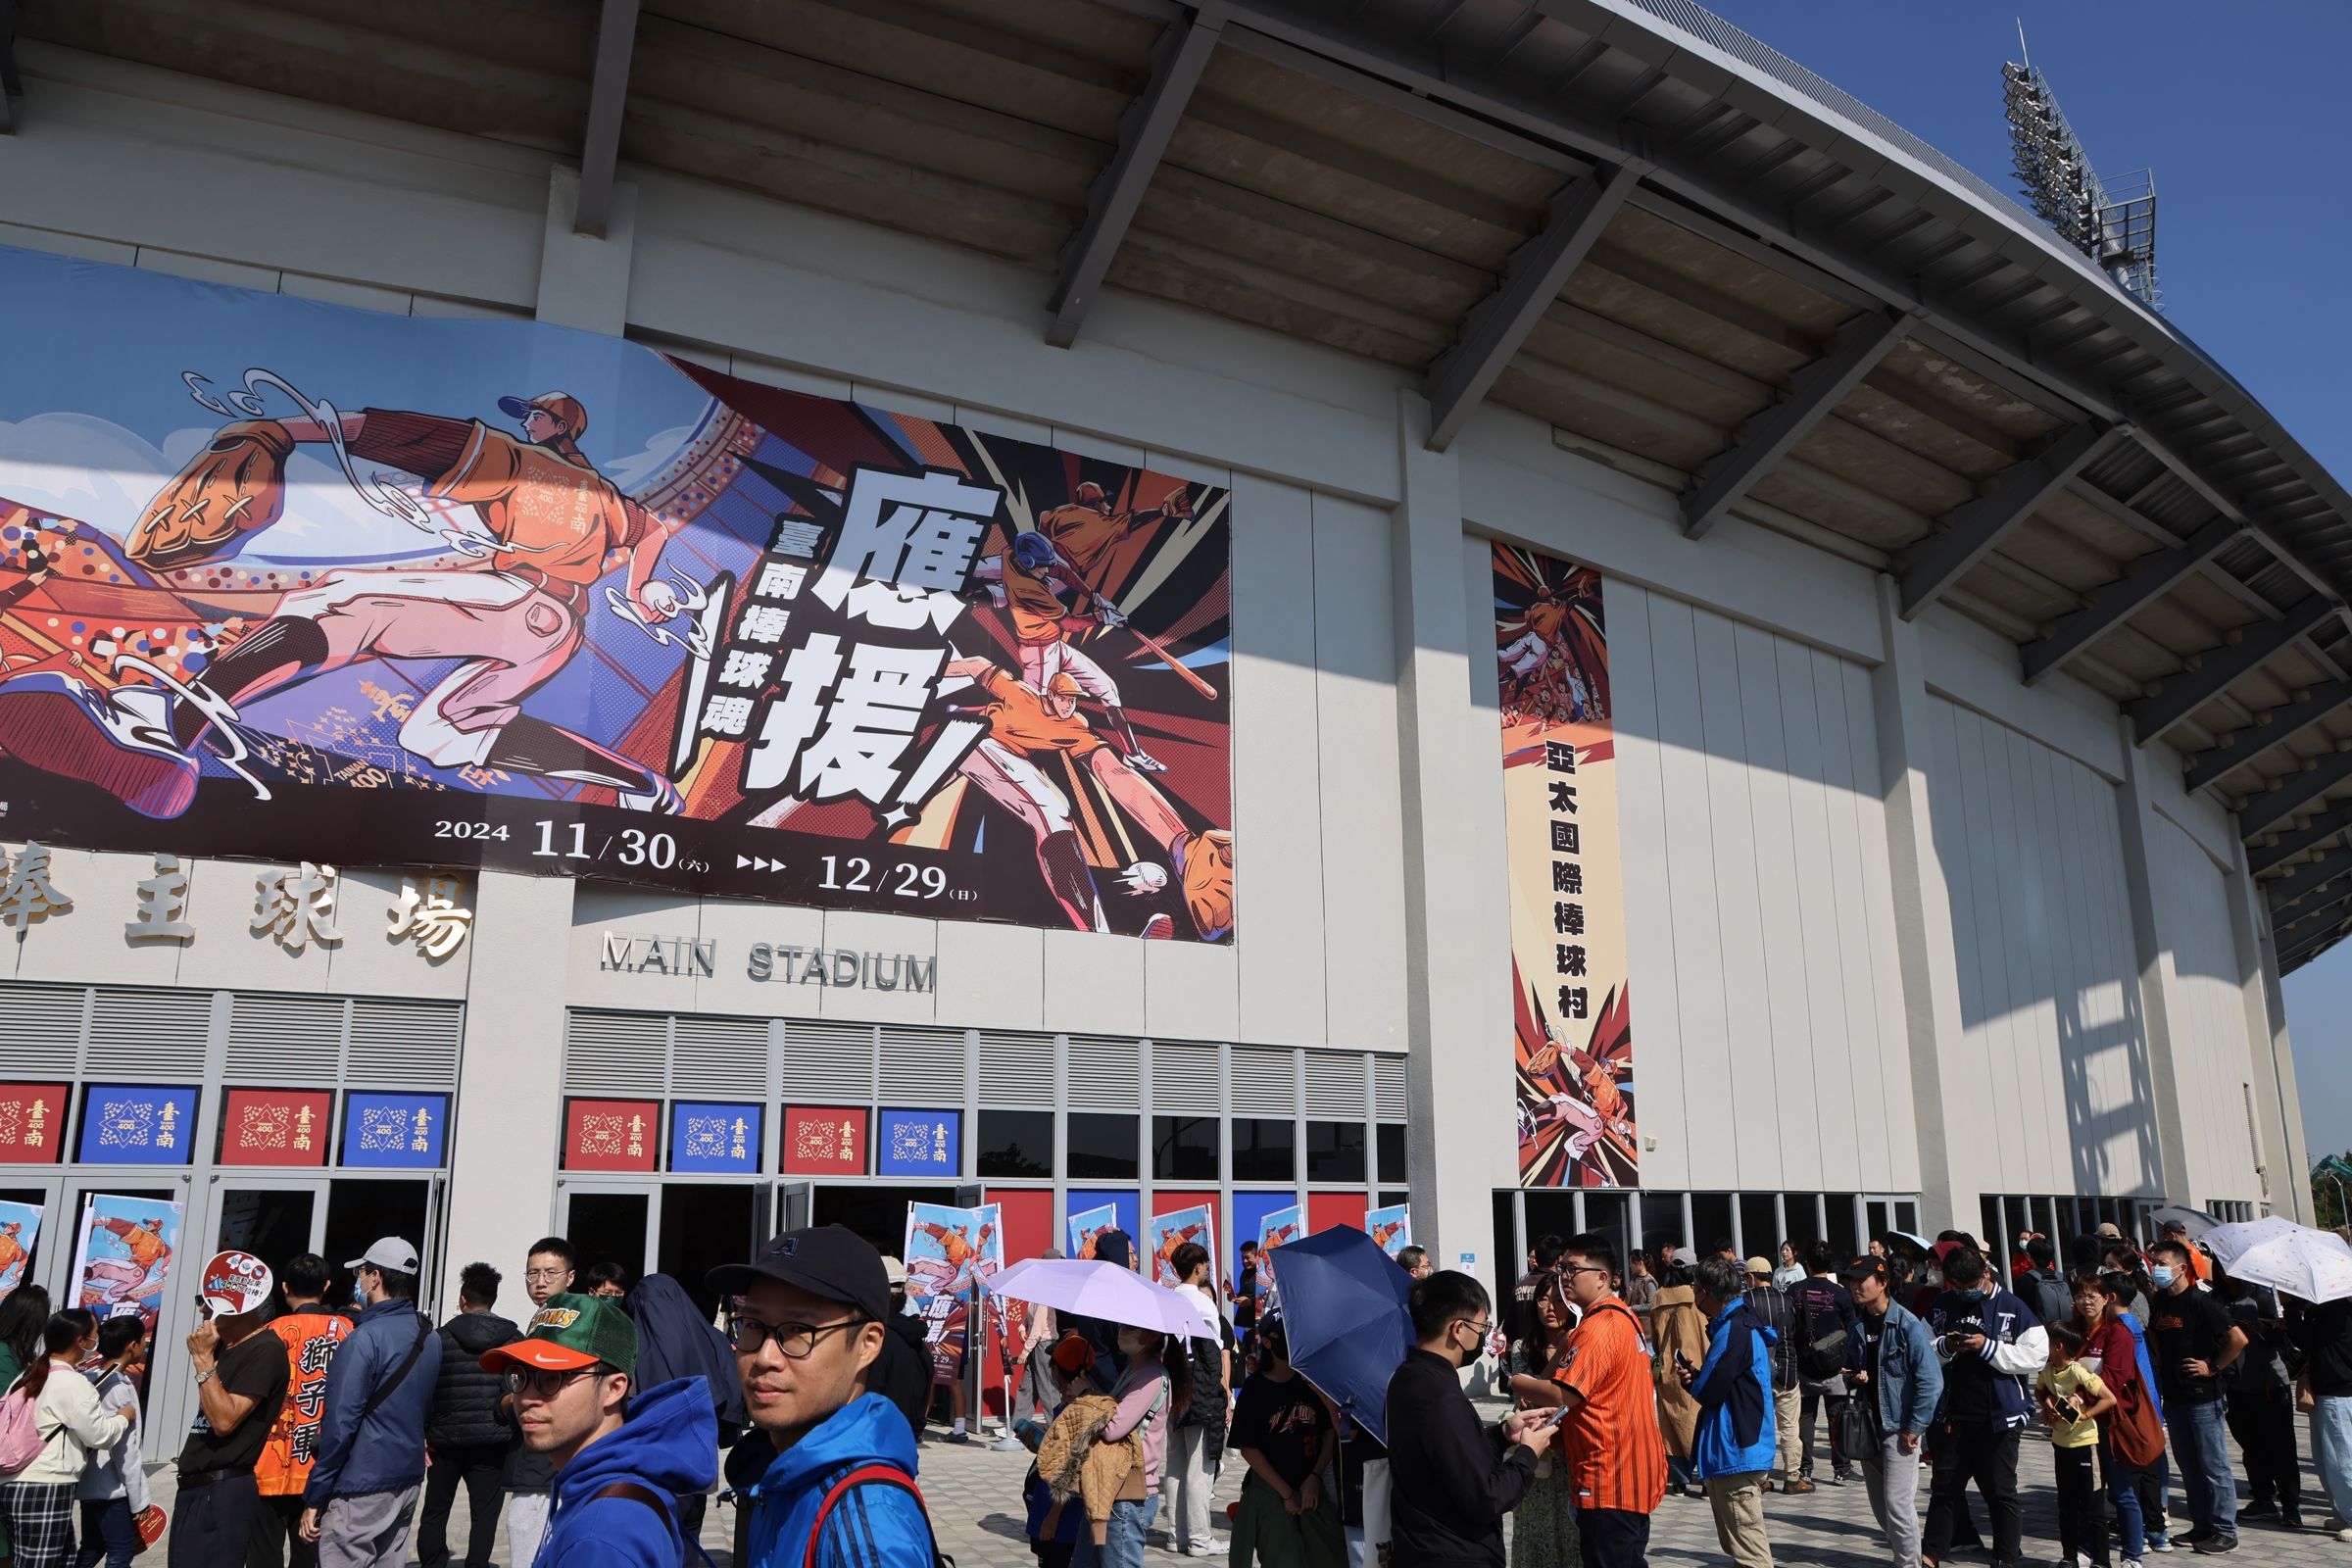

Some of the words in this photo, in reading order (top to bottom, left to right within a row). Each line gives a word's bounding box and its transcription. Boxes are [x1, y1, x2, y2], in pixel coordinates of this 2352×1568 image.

[700, 520, 825, 735] 臺南棒球魂
[334, 758, 369, 781] TAINAN
[435, 820, 510, 841] 2024
[1545, 740, 1589, 1019] 亞太國際棒球村
[601, 930, 716, 972] MAIN
[749, 942, 937, 987] STADIUM
